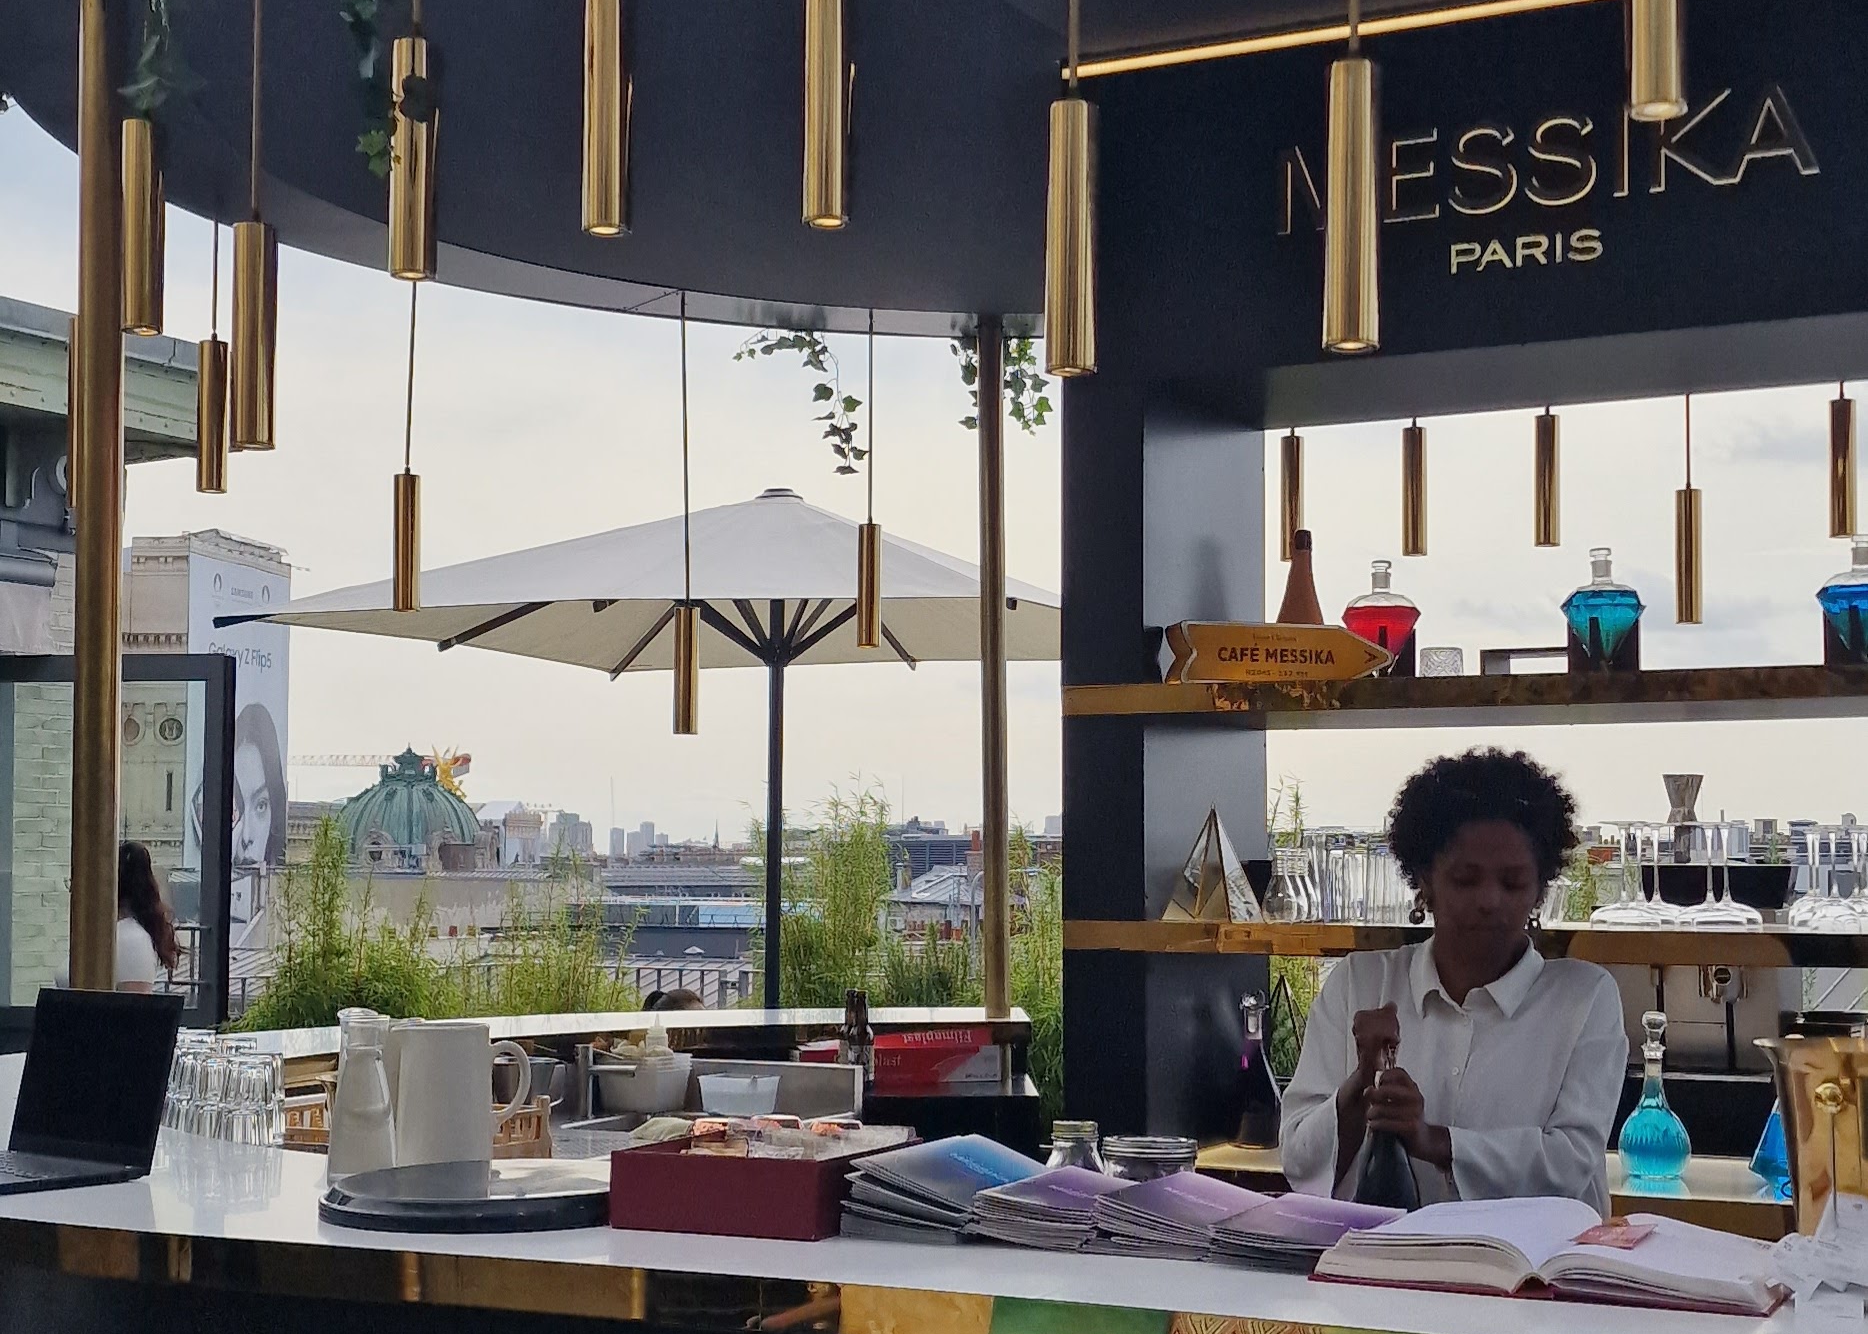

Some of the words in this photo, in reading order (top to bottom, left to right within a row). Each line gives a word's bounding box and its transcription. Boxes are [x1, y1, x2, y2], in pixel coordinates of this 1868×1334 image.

[1451, 228, 1604, 274] PARIS
[245, 648, 250, 665] Z
[1217, 643, 1260, 663] CAFÉ
[1265, 648, 1335, 665] MESSIKA
